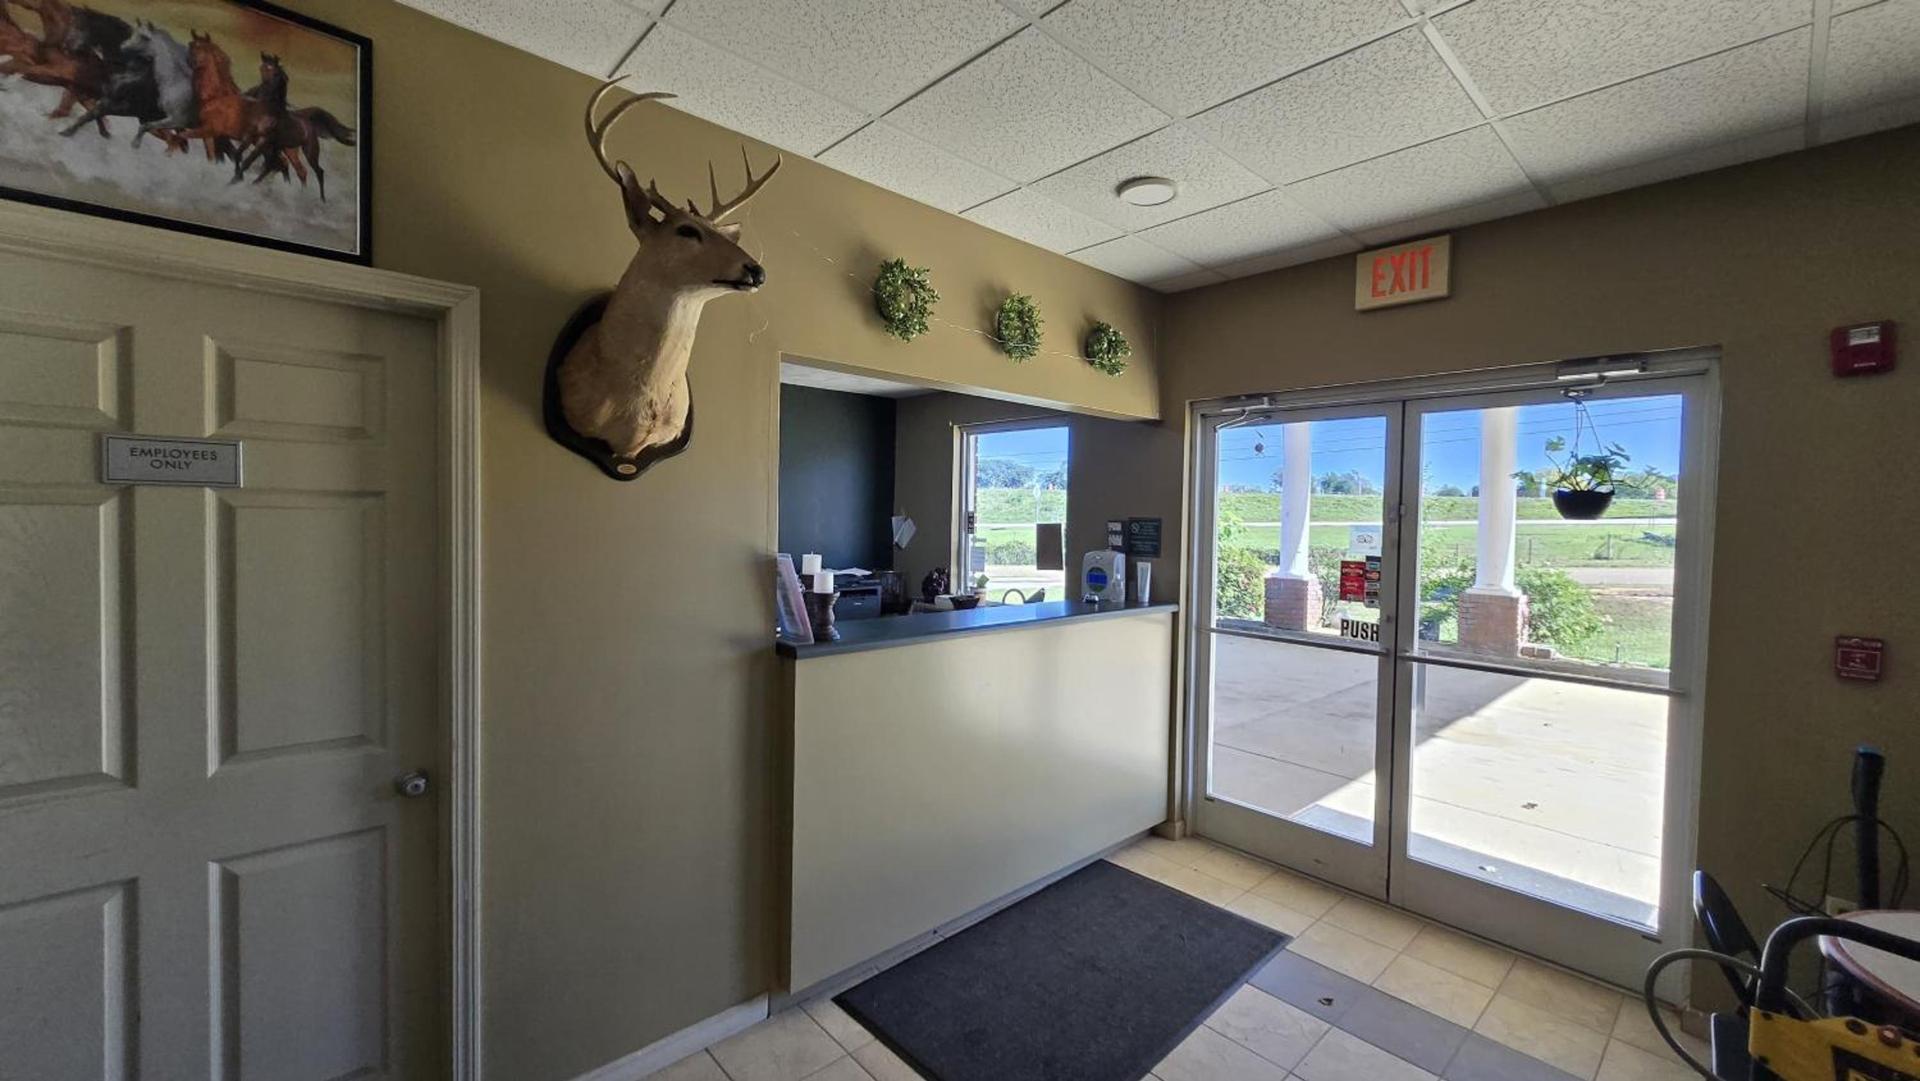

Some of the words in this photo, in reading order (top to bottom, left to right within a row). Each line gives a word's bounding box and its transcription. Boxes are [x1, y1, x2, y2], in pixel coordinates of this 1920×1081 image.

[1371, 245, 1433, 298] EXIT
[129, 447, 218, 461] EMPLOYEES
[150, 459, 193, 470] ONLY
[1341, 619, 1380, 642] PUSH
